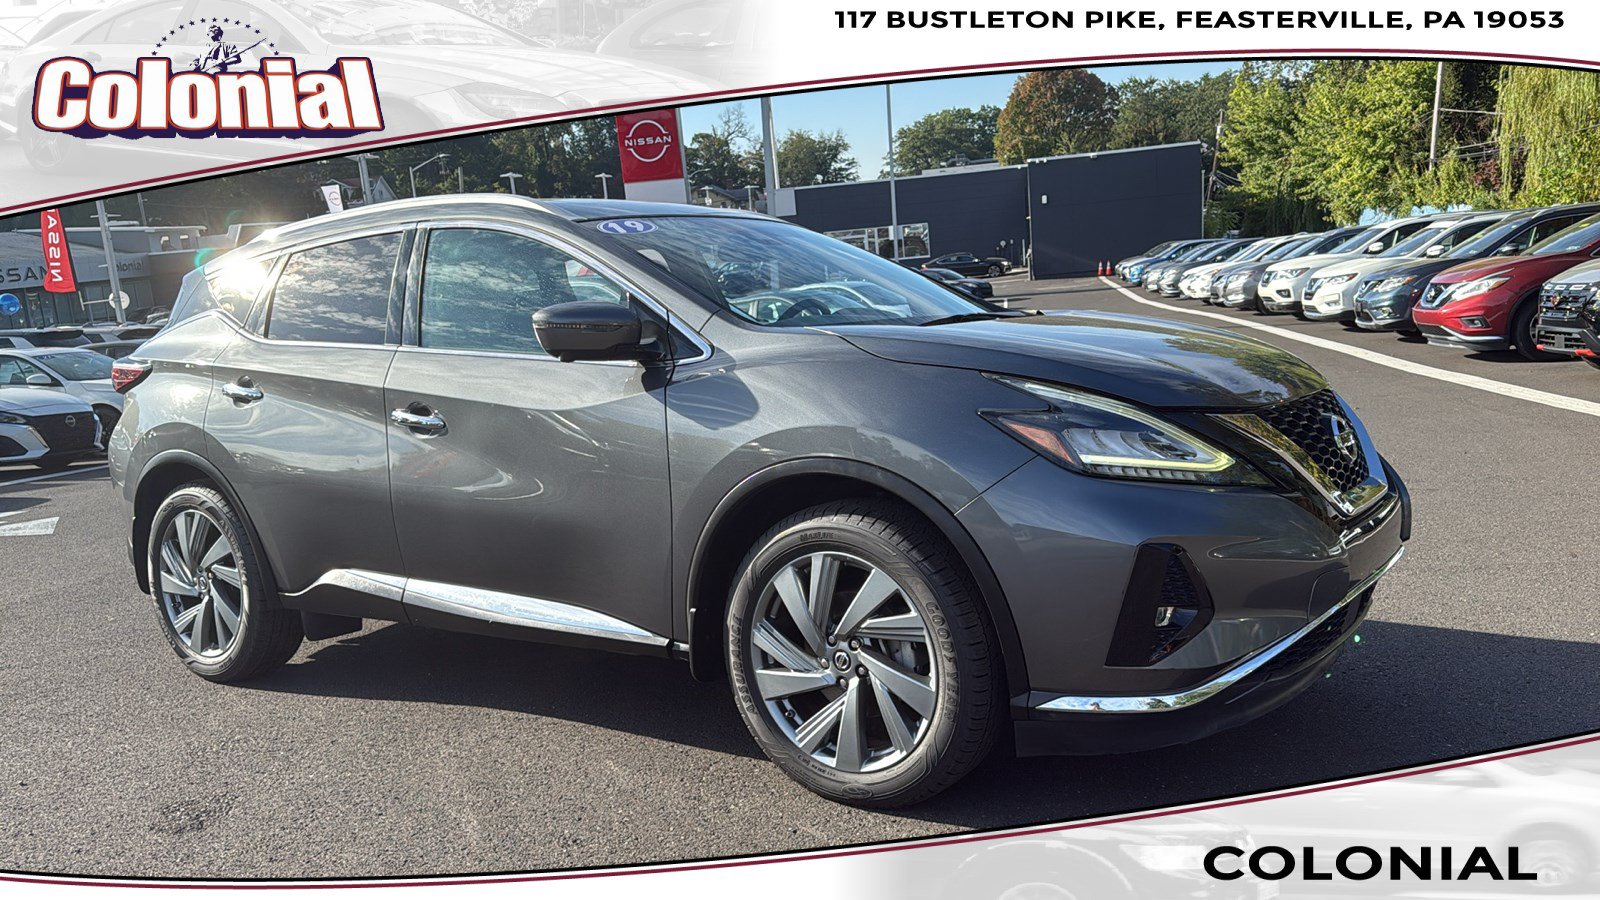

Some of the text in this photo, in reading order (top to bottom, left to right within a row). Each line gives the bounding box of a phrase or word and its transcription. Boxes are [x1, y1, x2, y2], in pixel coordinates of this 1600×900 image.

[624, 135, 672, 147] NISSAN
[608, 220, 644, 234] 19
[731, 613, 758, 715] ASSURANCE
